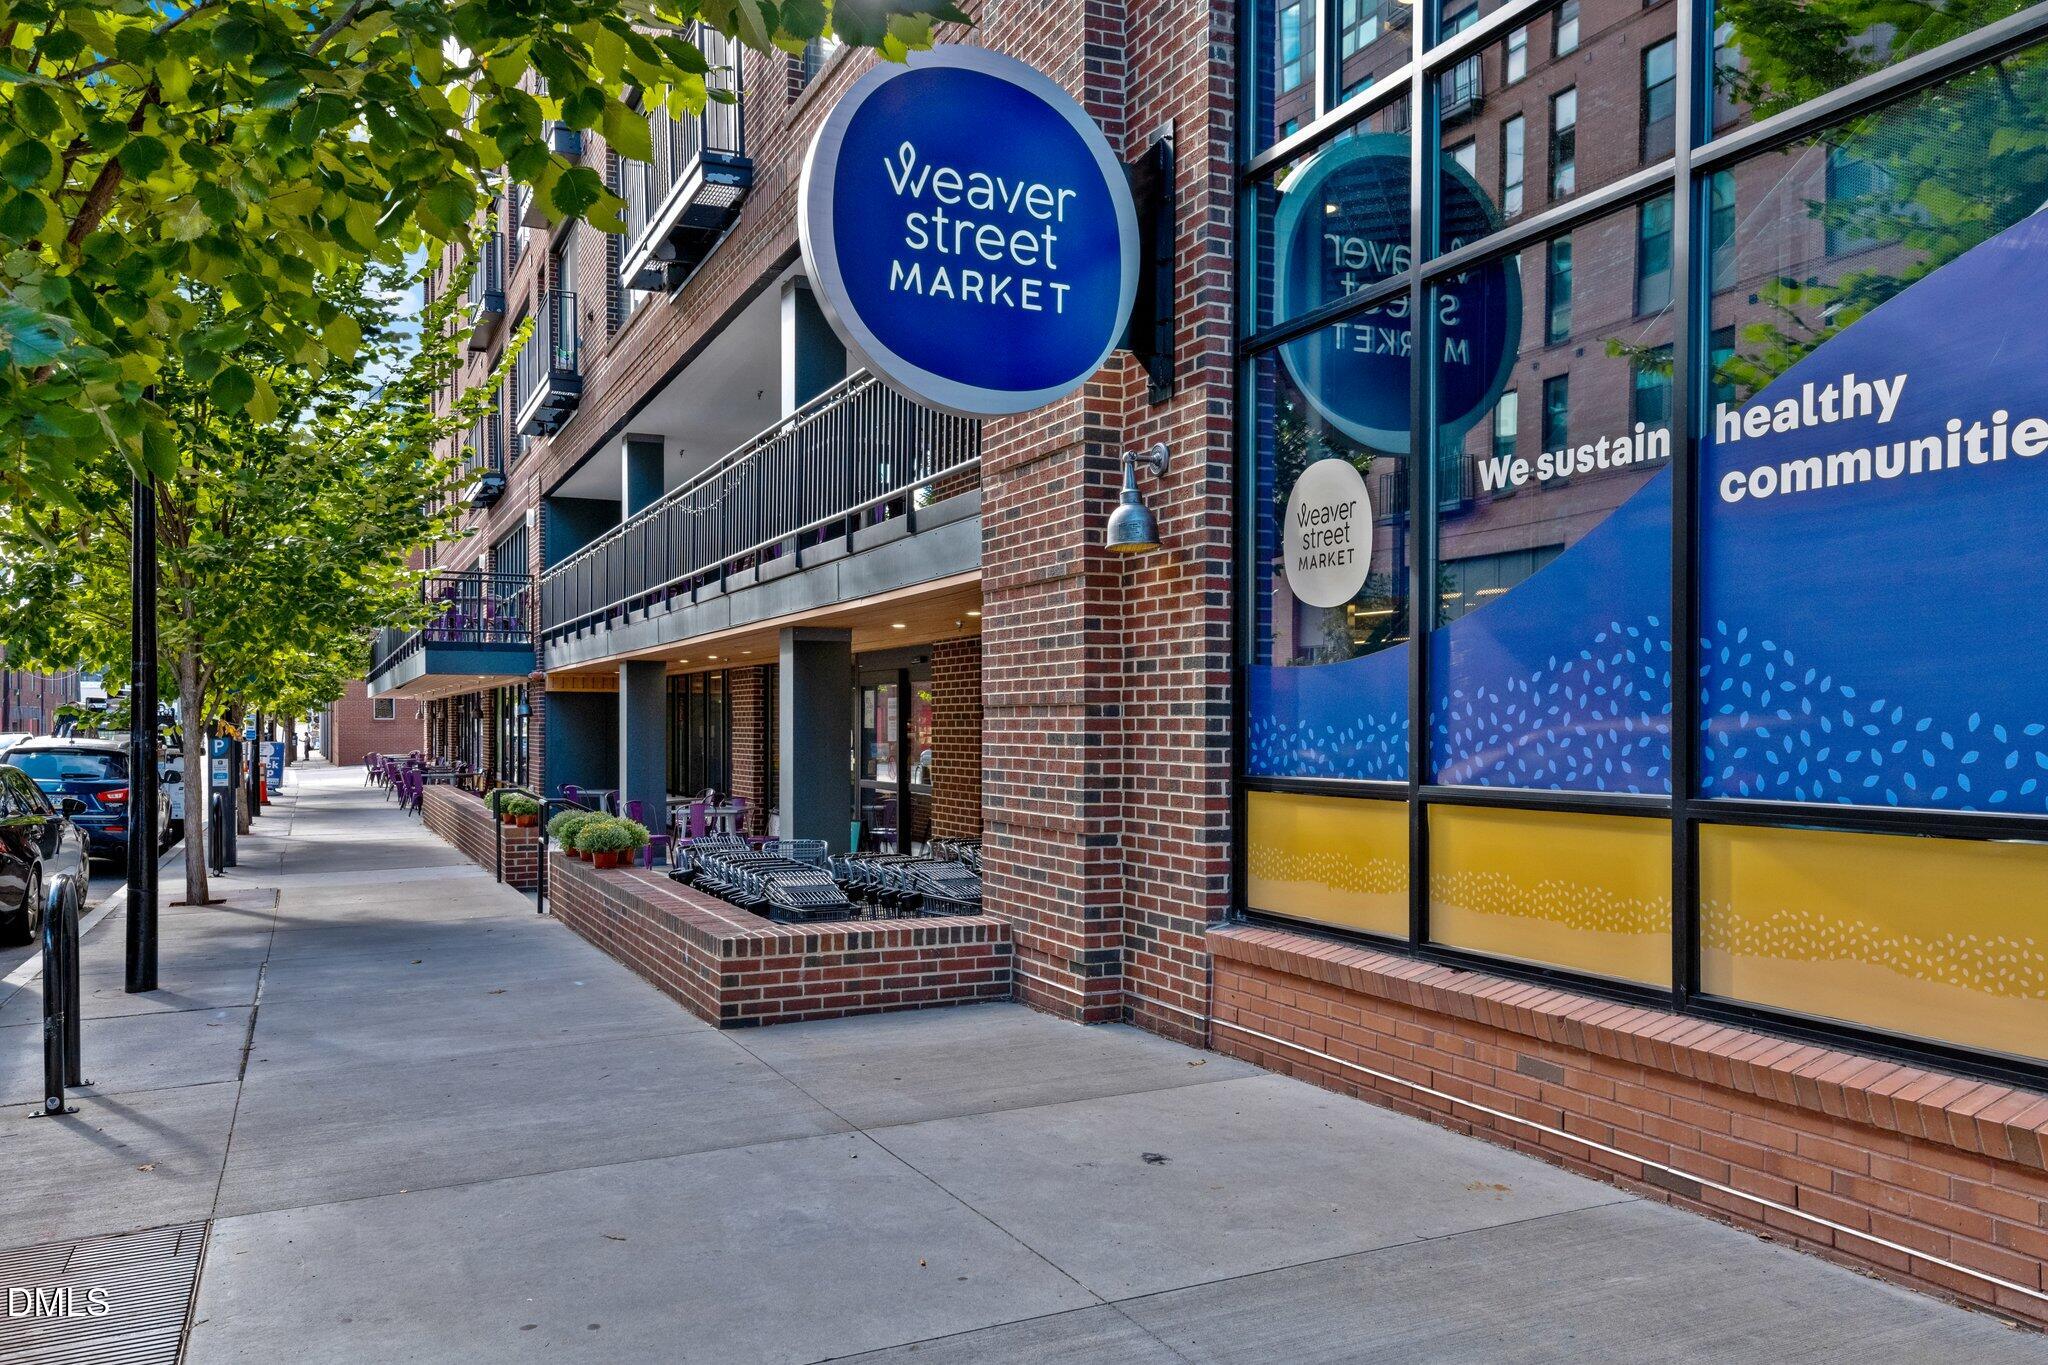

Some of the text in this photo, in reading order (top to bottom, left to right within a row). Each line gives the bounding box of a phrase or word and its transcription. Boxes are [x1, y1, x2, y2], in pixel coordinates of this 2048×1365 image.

[884, 140, 1077, 222] Weaver
[905, 206, 1058, 270] street
[889, 259, 1071, 314] MARKET
[1478, 373, 1908, 491] We sustain healthy
[1720, 409, 2048, 503] communitie
[1297, 500, 1357, 528] Weaver
[1302, 521, 1350, 550] street
[1298, 548, 1355, 571] MARKET
[214, 739, 225, 753] P
